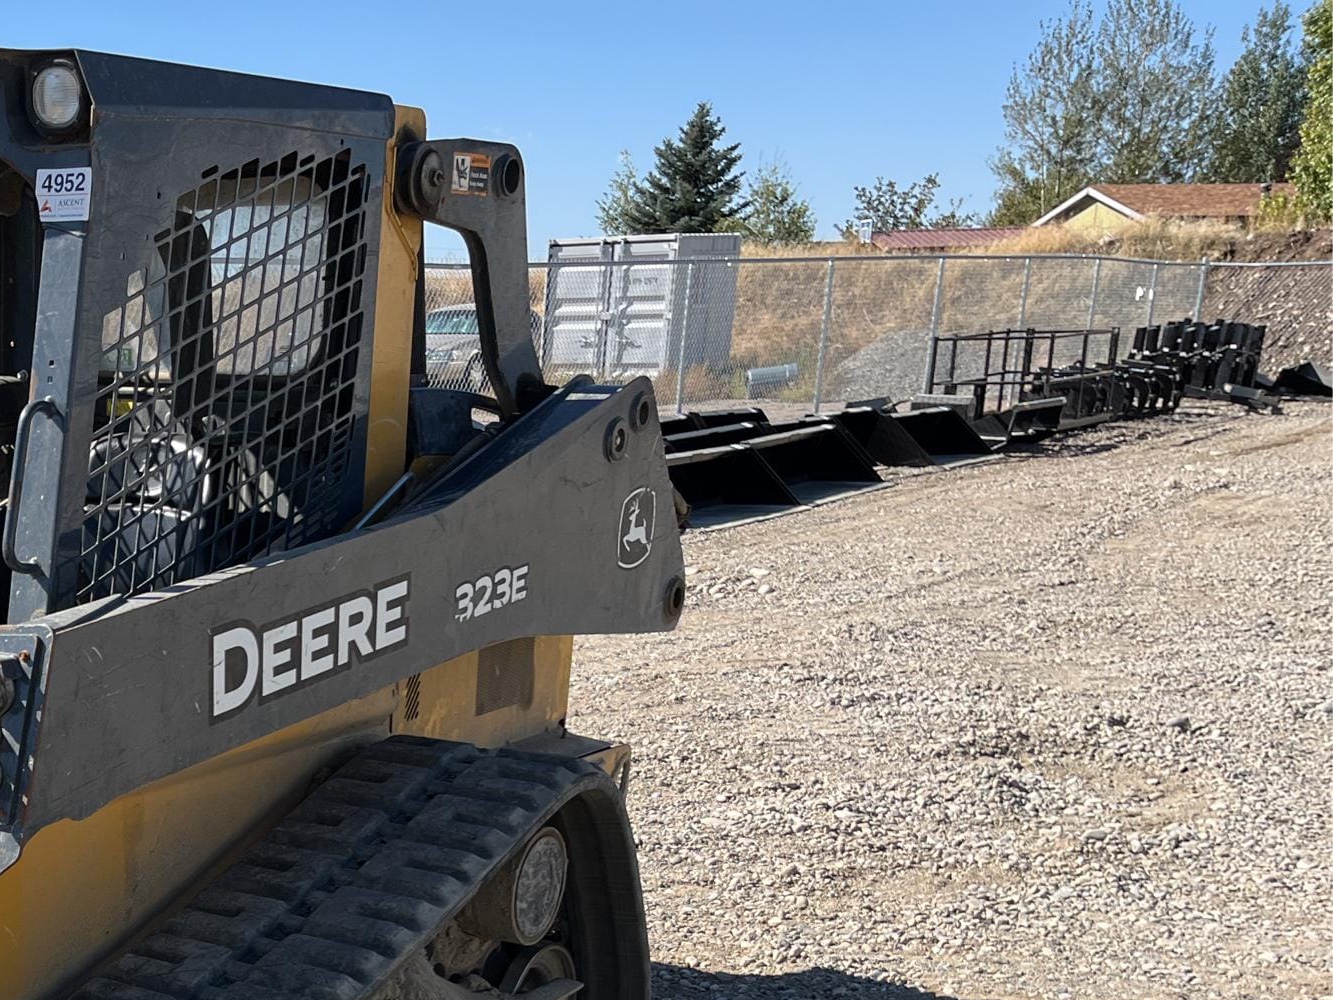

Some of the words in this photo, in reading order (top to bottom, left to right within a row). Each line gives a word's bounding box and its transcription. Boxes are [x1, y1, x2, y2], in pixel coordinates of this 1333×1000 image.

[42, 172, 86, 193] 4952
[57, 198, 85, 207] ASCENT
[213, 580, 408, 717] DEERE
[455, 565, 529, 622] 323E
